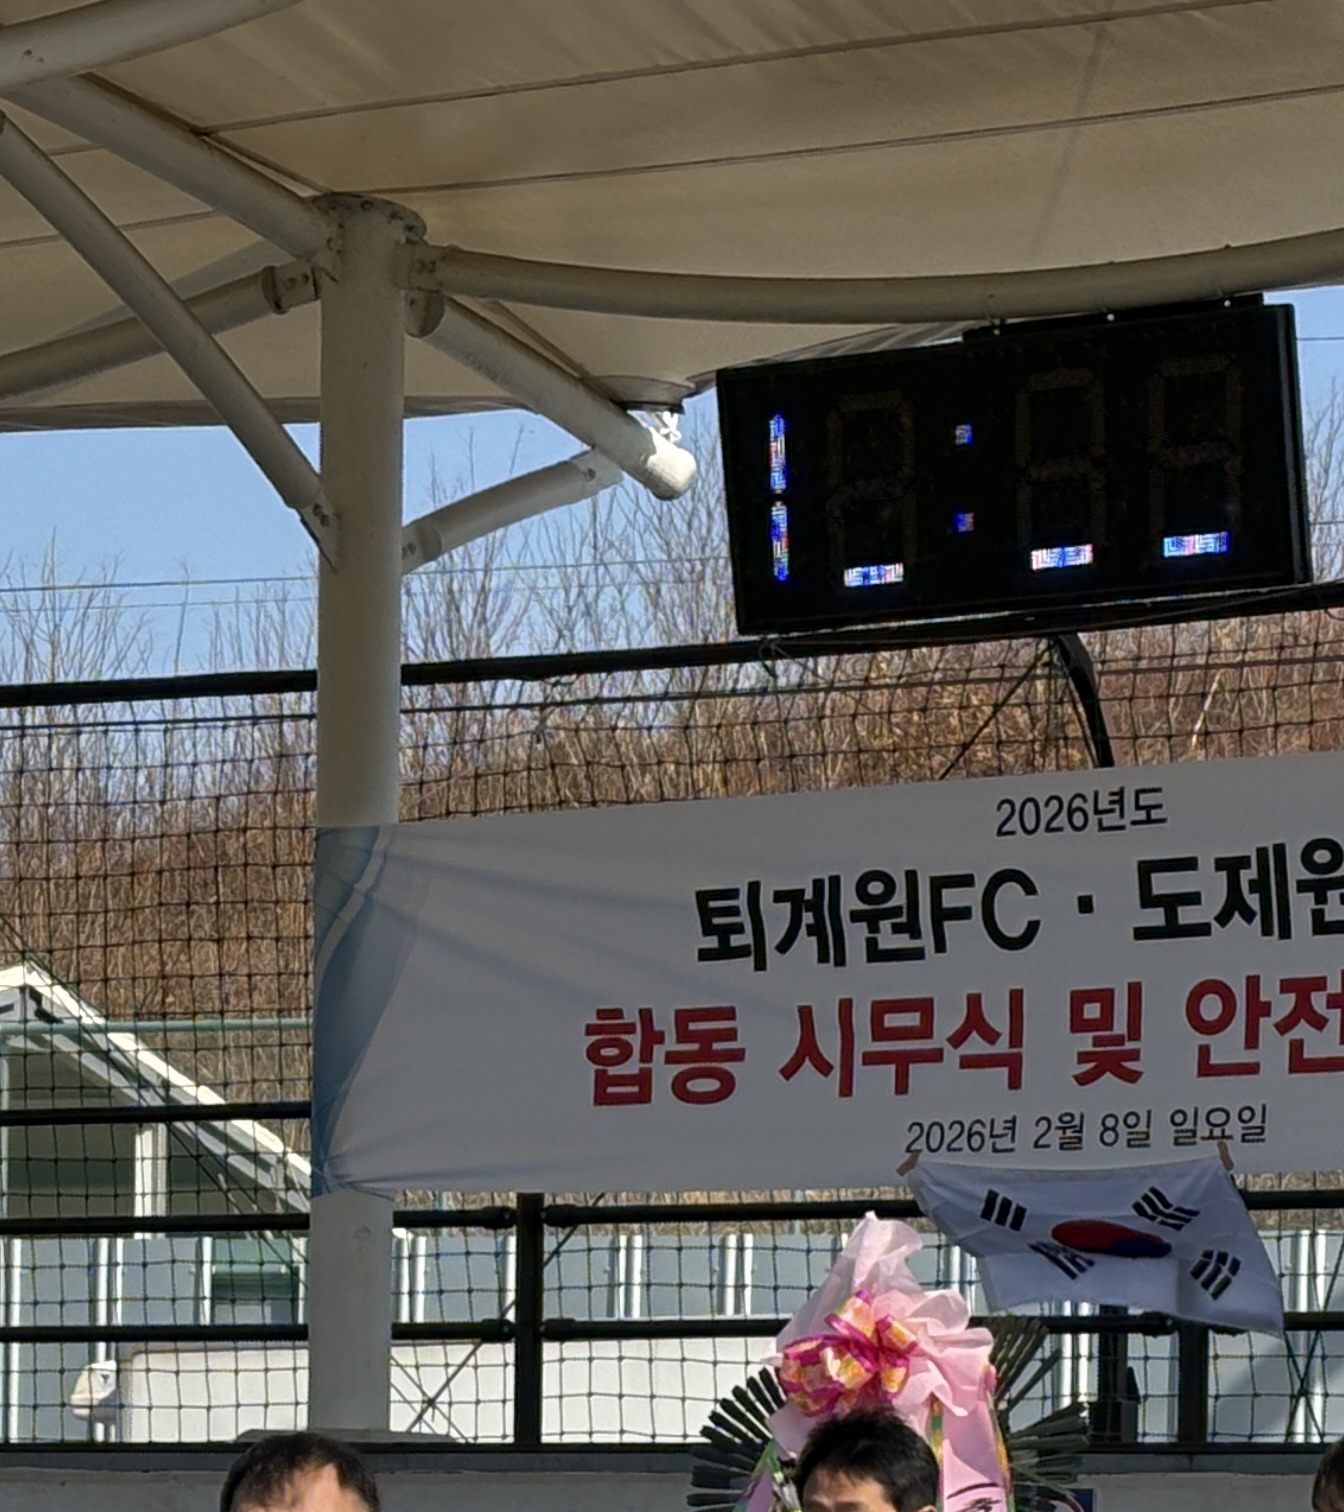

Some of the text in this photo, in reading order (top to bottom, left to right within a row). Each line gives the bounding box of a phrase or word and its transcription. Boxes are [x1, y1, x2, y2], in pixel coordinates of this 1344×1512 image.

[995, 785, 1169, 838] 2026년도
[694, 867, 1042, 973] 퇴계원FC
[587, 1008, 743, 1104] 합동
[783, 991, 1021, 1095] 시무식
[1071, 986, 1139, 1084] 및
[904, 1103, 1267, 1155] 2026년 2월 8일 일요일
